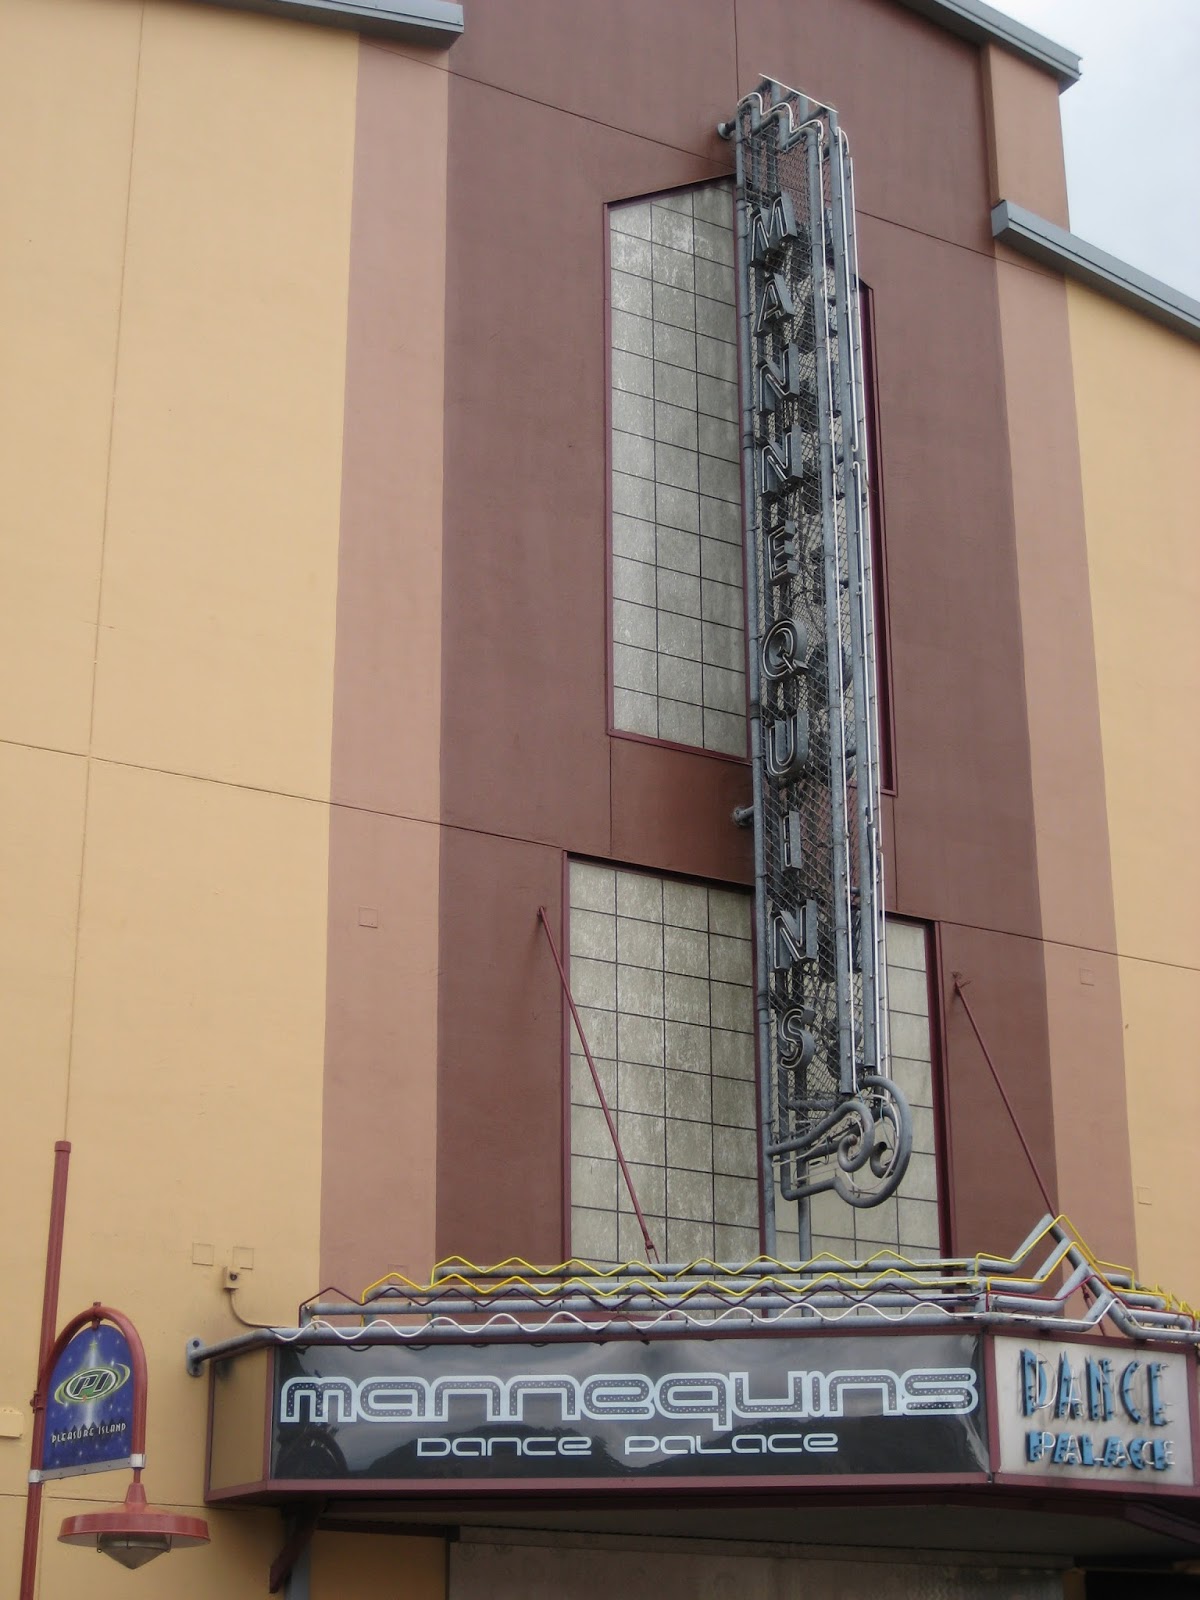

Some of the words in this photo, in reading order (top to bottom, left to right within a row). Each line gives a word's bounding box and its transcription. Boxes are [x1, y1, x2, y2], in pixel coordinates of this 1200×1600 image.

[750, 192, 818, 1072] MANNEQUINS
[72, 1372, 109, 1396] PI
[280, 1367, 978, 1431] mannequins
[1020, 1348, 1173, 1426] DANCE
[51, 1427, 94, 1443] PLEASURE
[98, 1422, 127, 1435] ISLAND
[1026, 1430, 1175, 1470] PALACE
